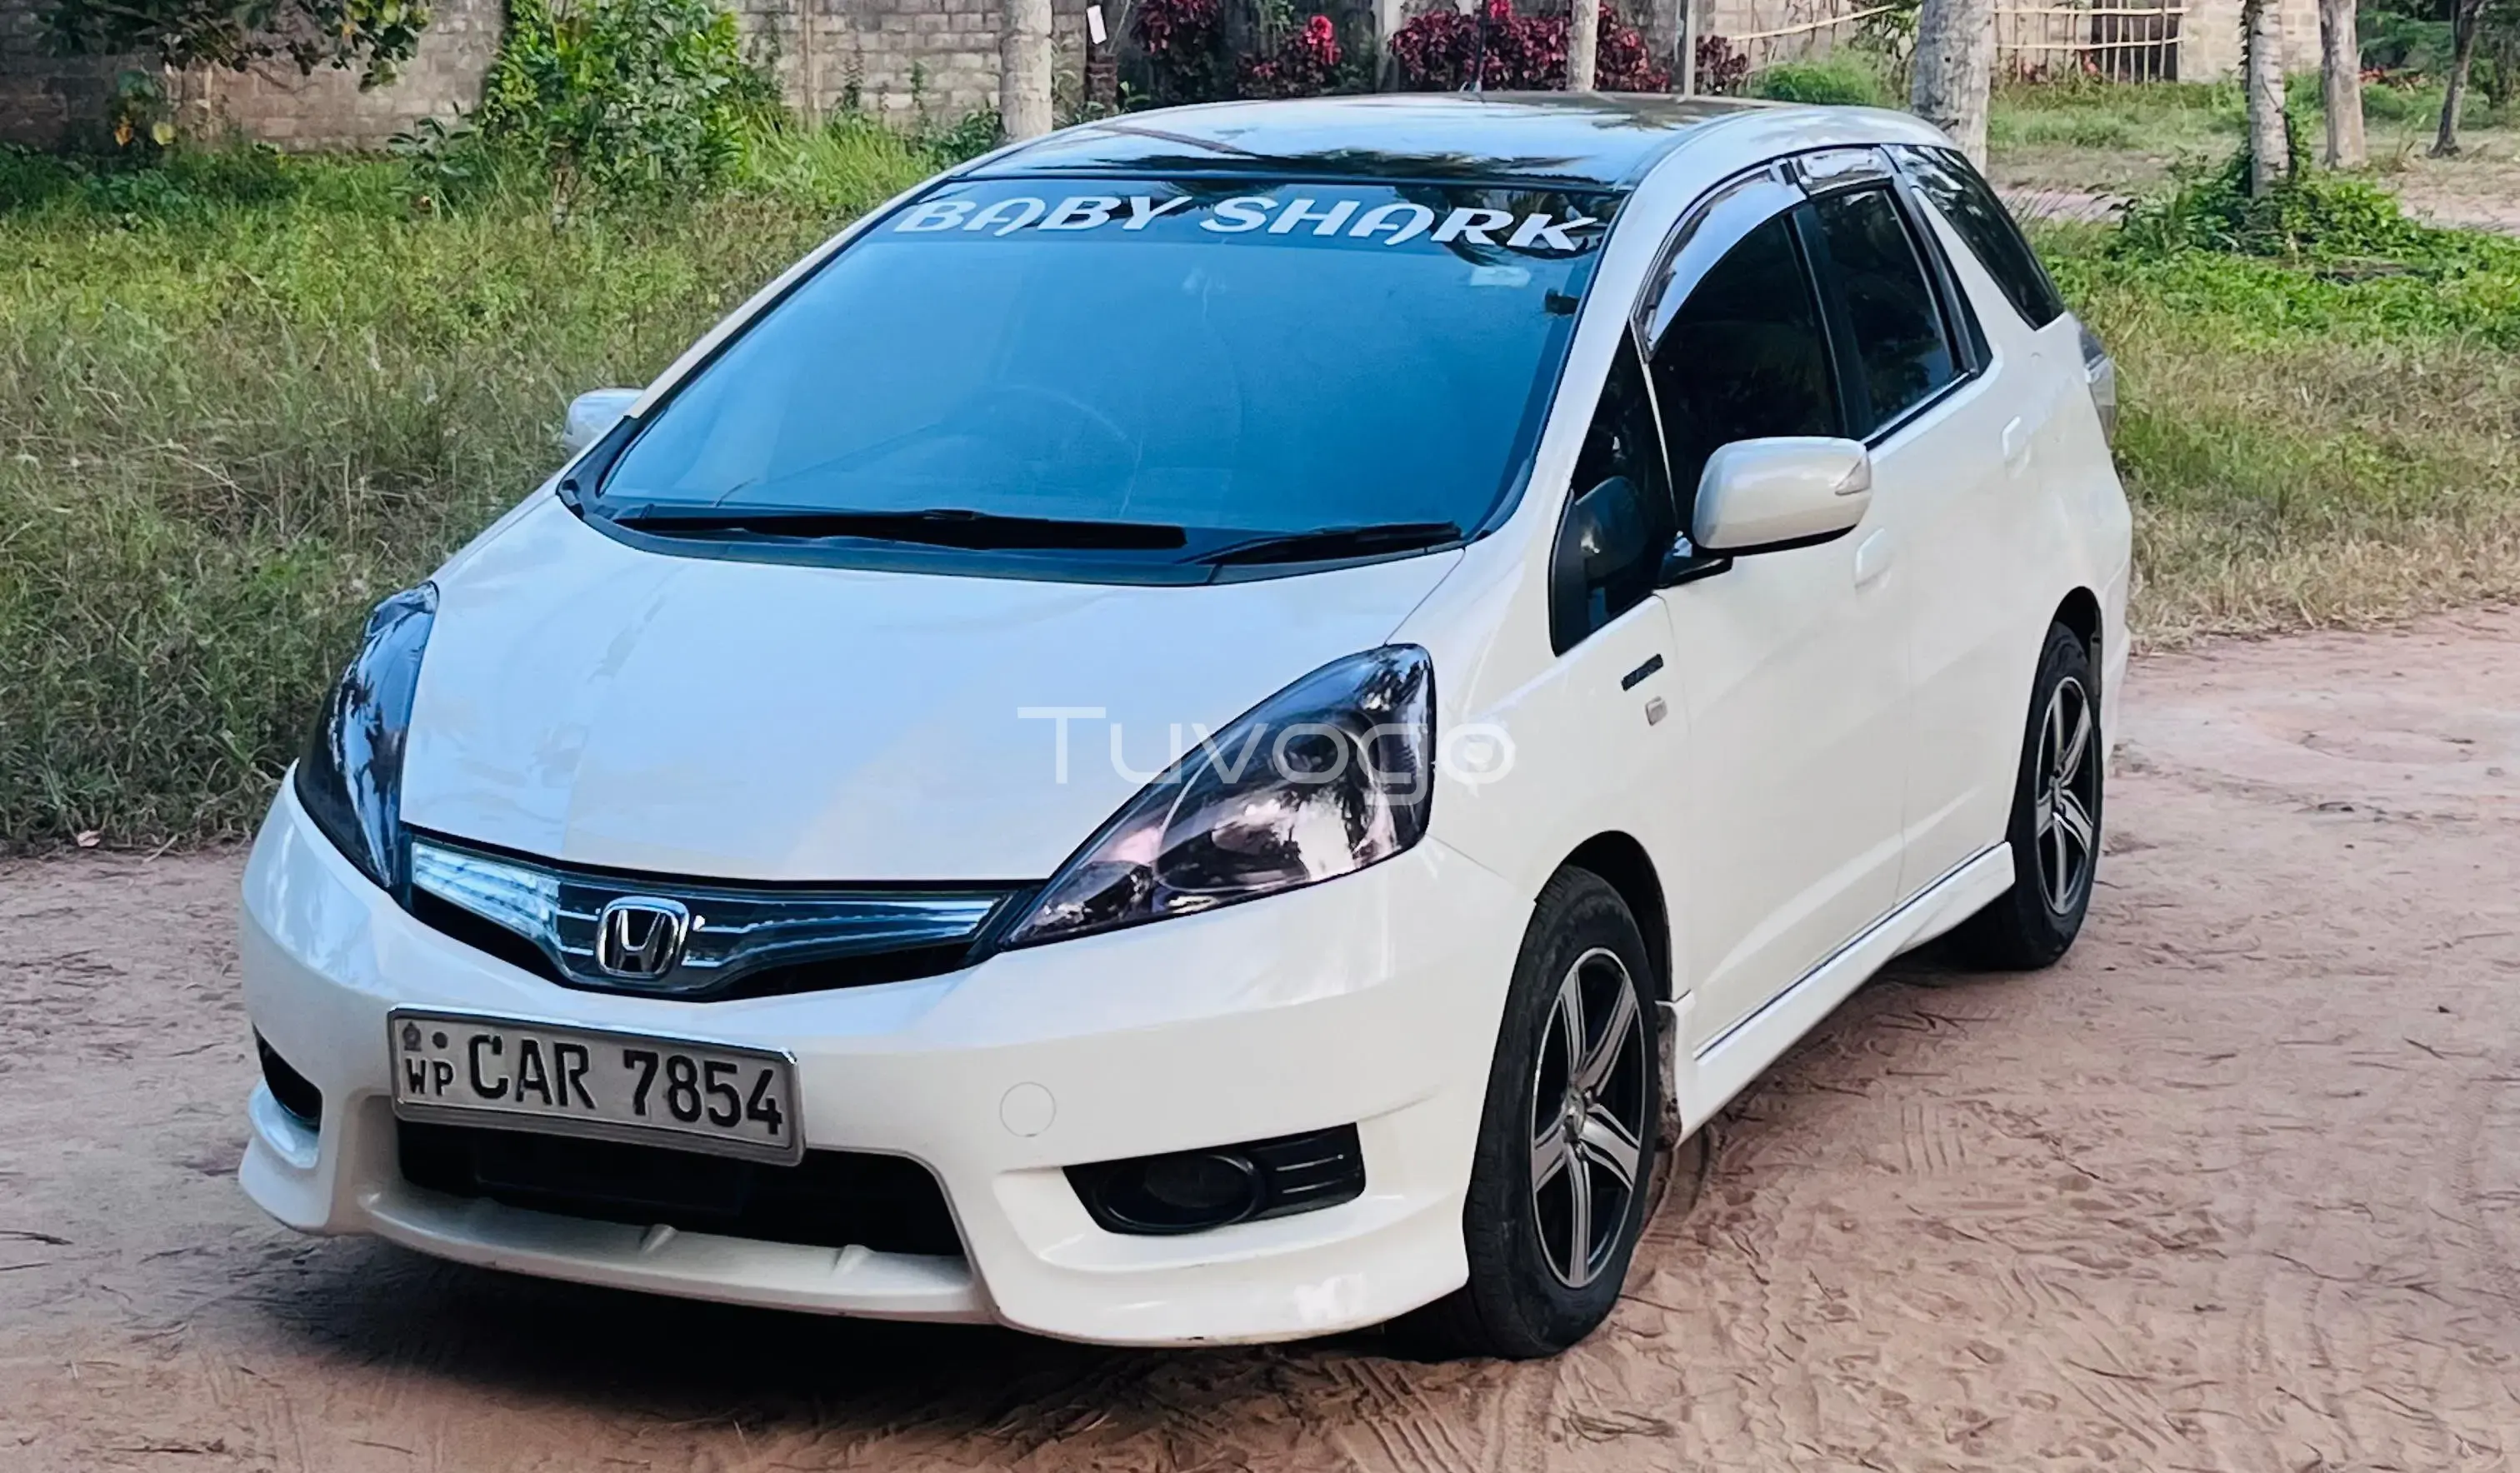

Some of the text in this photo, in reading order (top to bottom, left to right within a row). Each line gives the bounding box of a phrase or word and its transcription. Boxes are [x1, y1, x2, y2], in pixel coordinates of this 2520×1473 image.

[894, 195, 1597, 252] BABY SHARK
[406, 1034, 783, 1135] WP CAR 7854
